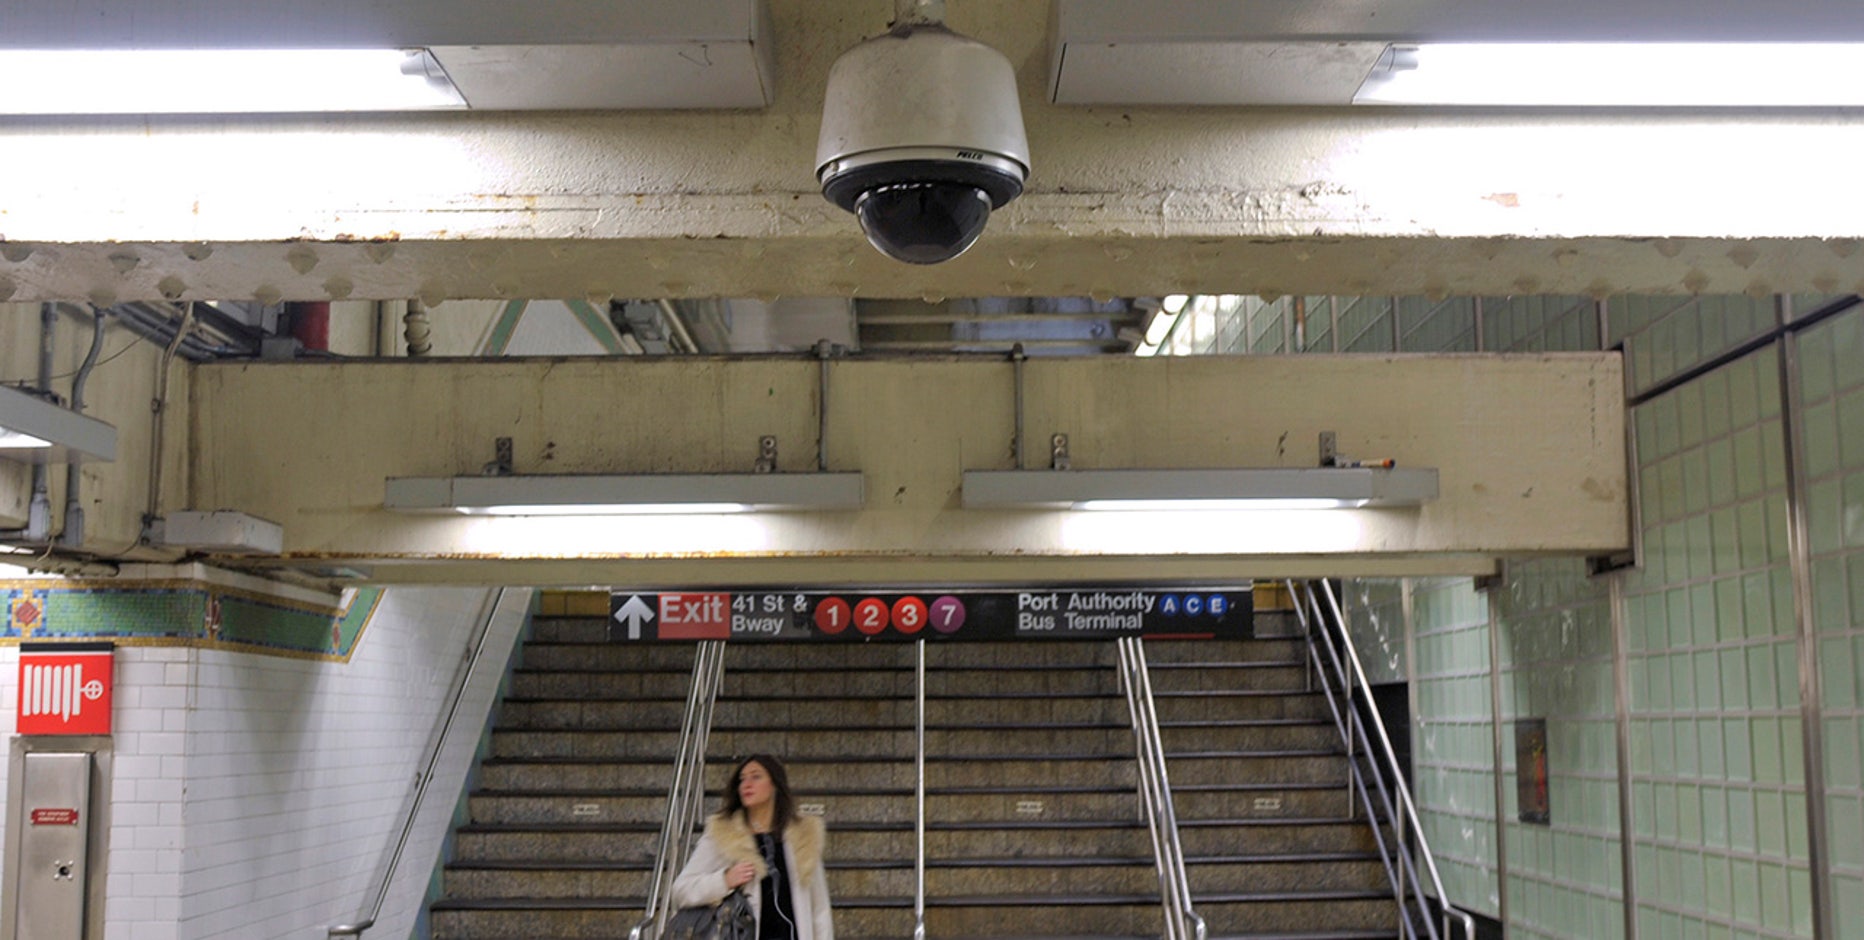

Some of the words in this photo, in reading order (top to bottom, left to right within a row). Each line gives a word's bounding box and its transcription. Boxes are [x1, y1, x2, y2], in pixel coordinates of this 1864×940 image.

[660, 595, 723, 624] Exit
[732, 595, 755, 611] 41
[763, 594, 785, 612] St
[792, 594, 808, 613] &
[1018, 593, 1059, 611] Port
[1068, 592, 1155, 613] Authority
[1163, 598, 1176, 613] A
[1186, 597, 1200, 614] C
[1210, 597, 1222, 614] E
[827, 605, 838, 627] 1
[862, 604, 879, 627] 2
[901, 603, 918, 626] 3
[940, 605, 957, 626] 7
[1018, 613, 1056, 631] Bus
[1065, 611, 1143, 630] Terminal
[732, 616, 784, 636] Bway
